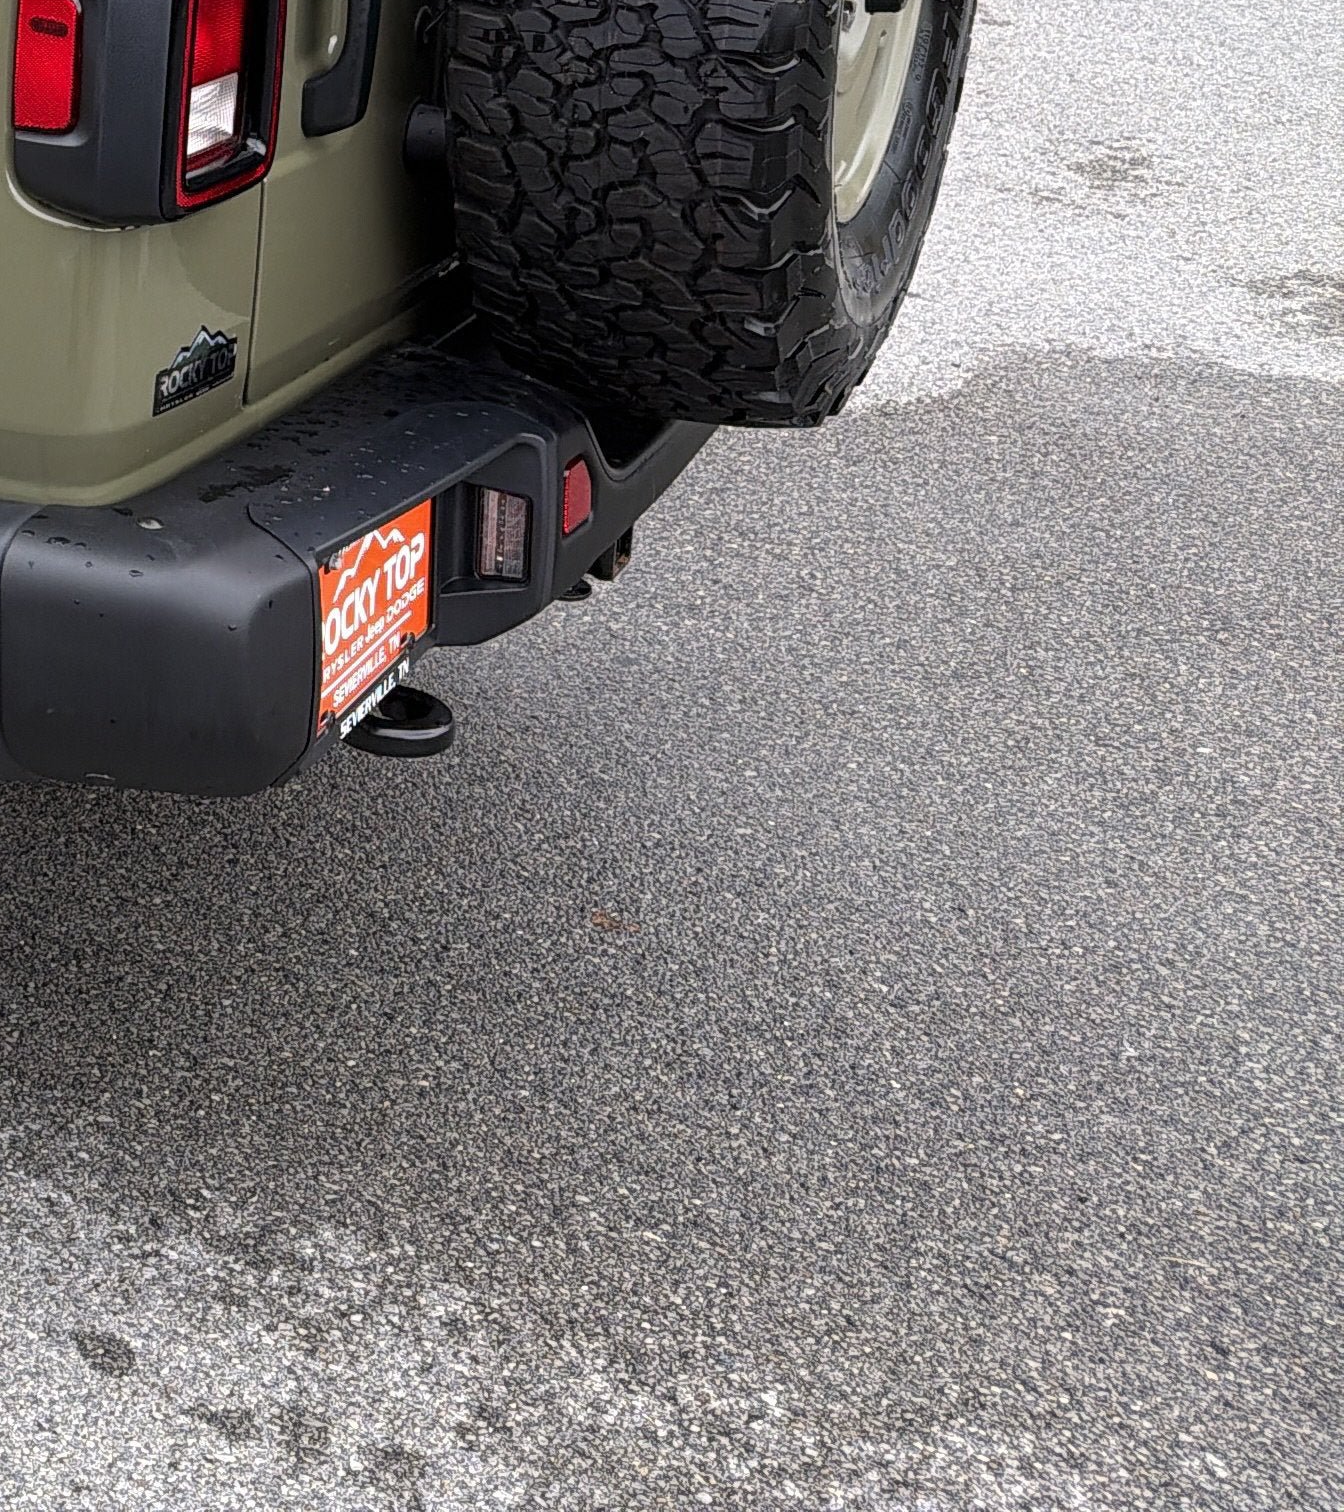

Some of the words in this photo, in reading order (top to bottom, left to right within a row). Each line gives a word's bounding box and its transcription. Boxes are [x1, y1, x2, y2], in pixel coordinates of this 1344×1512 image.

[159, 356, 206, 398] ROCKY
[321, 568, 380, 662] OCKY
[384, 532, 425, 601] TOP
[322, 634, 364, 684] RYSLER
[365, 616, 385, 644] Jeep
[385, 577, 425, 623] DODGE
[389, 630, 401, 655] TN
[397, 656, 410, 685] TN
